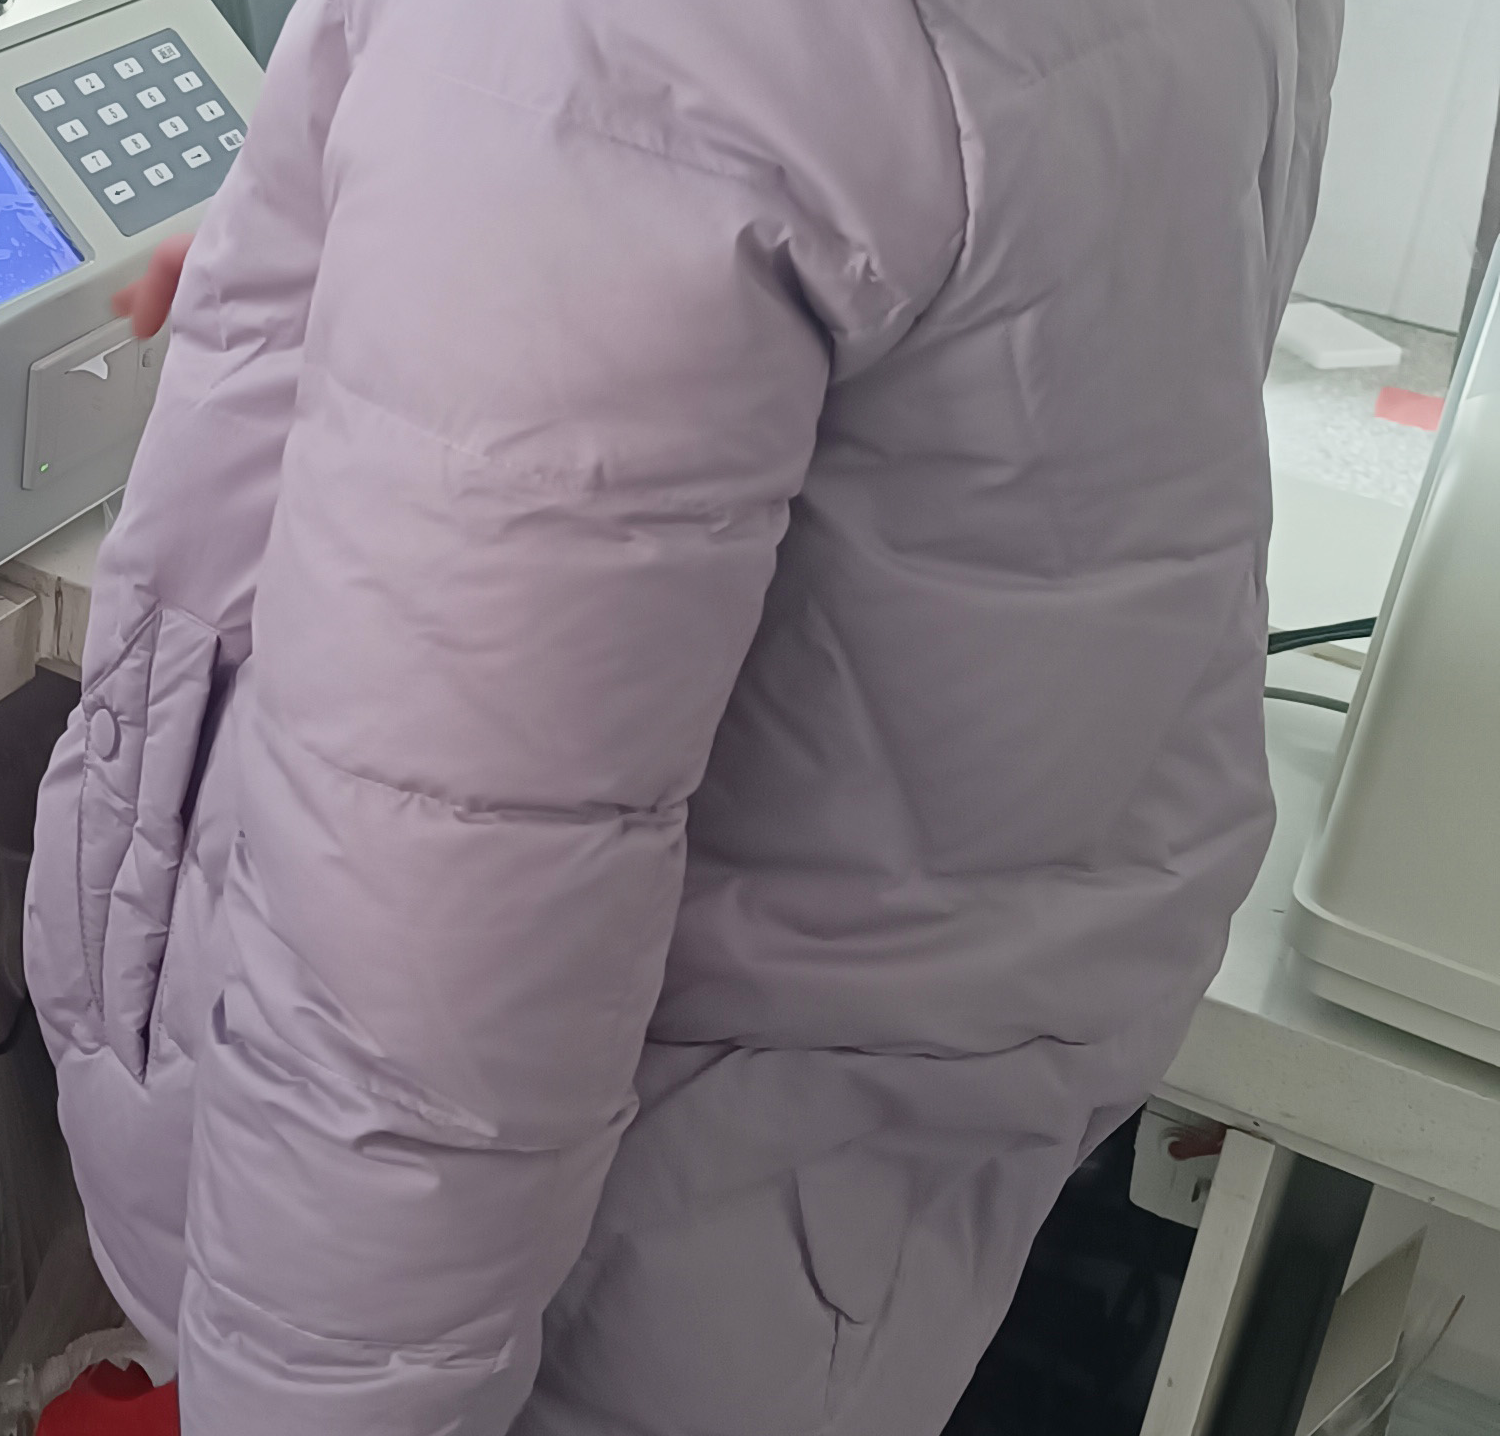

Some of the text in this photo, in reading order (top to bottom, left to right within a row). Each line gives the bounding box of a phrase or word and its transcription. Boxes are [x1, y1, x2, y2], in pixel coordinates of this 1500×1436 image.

[85, 78, 96, 90] 2
[124, 62, 135, 74] 3
[69, 91, 157, 136] 4 5 6
[91, 121, 180, 167] 7 8 9
[154, 168, 165, 180] 0
